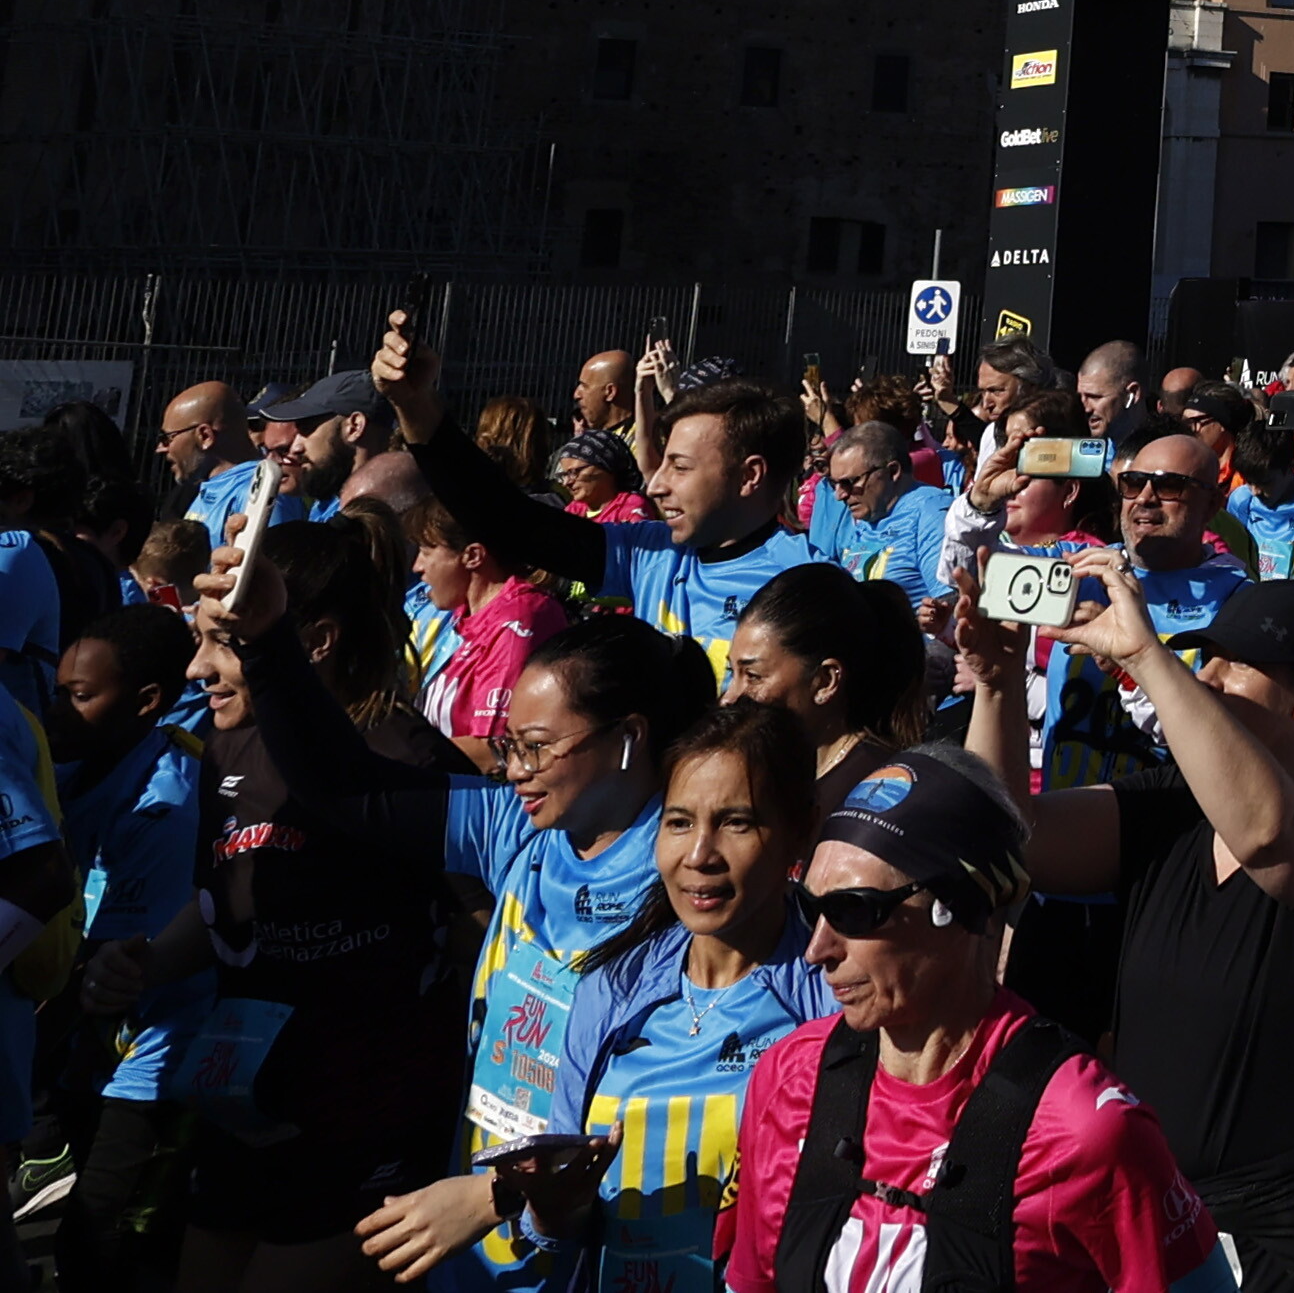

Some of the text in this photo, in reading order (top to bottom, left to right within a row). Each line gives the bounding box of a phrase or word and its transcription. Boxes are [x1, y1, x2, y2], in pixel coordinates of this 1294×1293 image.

[1001, 187, 1048, 205] MASSIGEN
[1003, 249, 1050, 265] DELTA
[915, 328, 947, 338] PEDONI
[253, 918, 343, 944] Atletica
[523, 992, 547, 1020] FUN
[502, 1005, 554, 1049] RUN
[716, 1063, 744, 1073] acea
